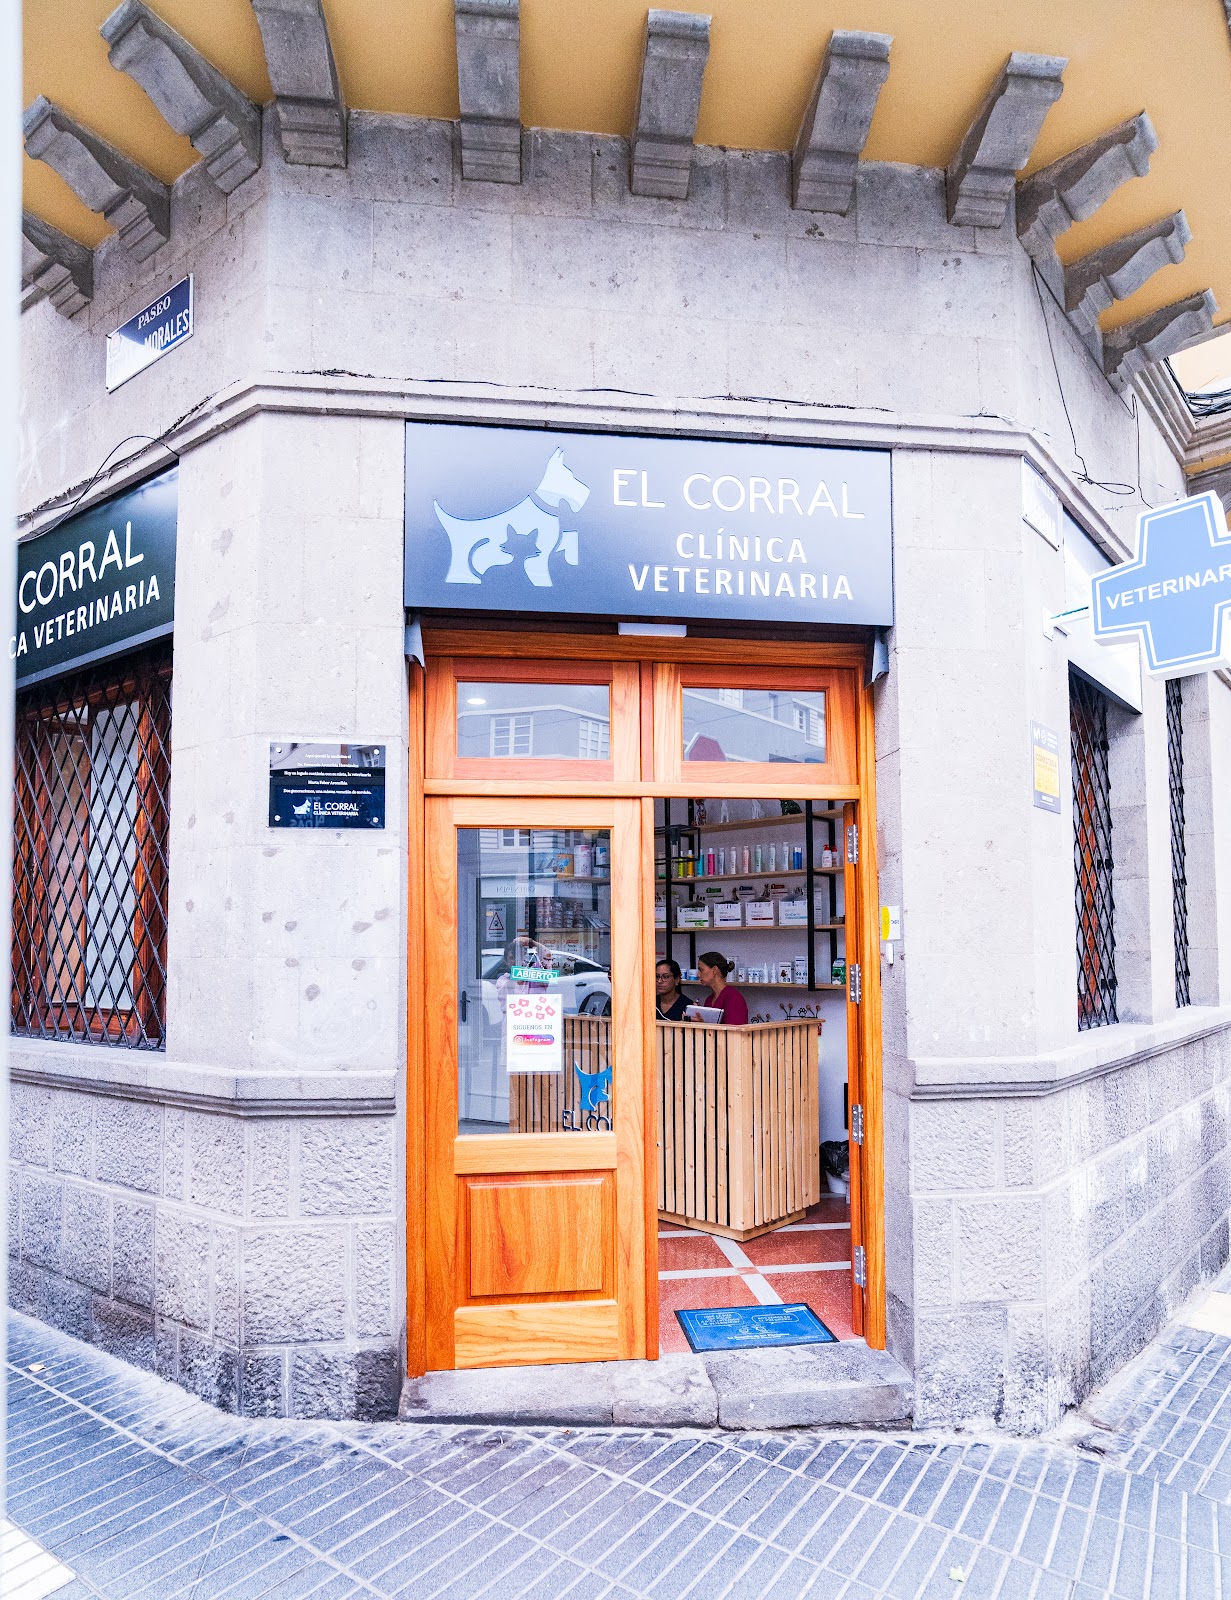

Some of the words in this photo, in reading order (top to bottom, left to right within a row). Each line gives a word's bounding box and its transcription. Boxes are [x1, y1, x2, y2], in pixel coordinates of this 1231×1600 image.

[138, 295, 171, 330] PASEO
[613, 468, 666, 508] EL
[683, 473, 865, 519] CORRAL
[676, 528, 807, 564] CLÍNICA
[18, 521, 144, 614] CORRAL
[628, 563, 854, 601] VETERINARIA
[34, 575, 160, 649] VETERINARIA
[313, 801, 323, 810] EL
[324, 802, 359, 811] CORRAL
[516, 969, 554, 980] ABIERTO
[524, 1036, 551, 1044] Instagram
[562, 1109, 582, 1131] EL
